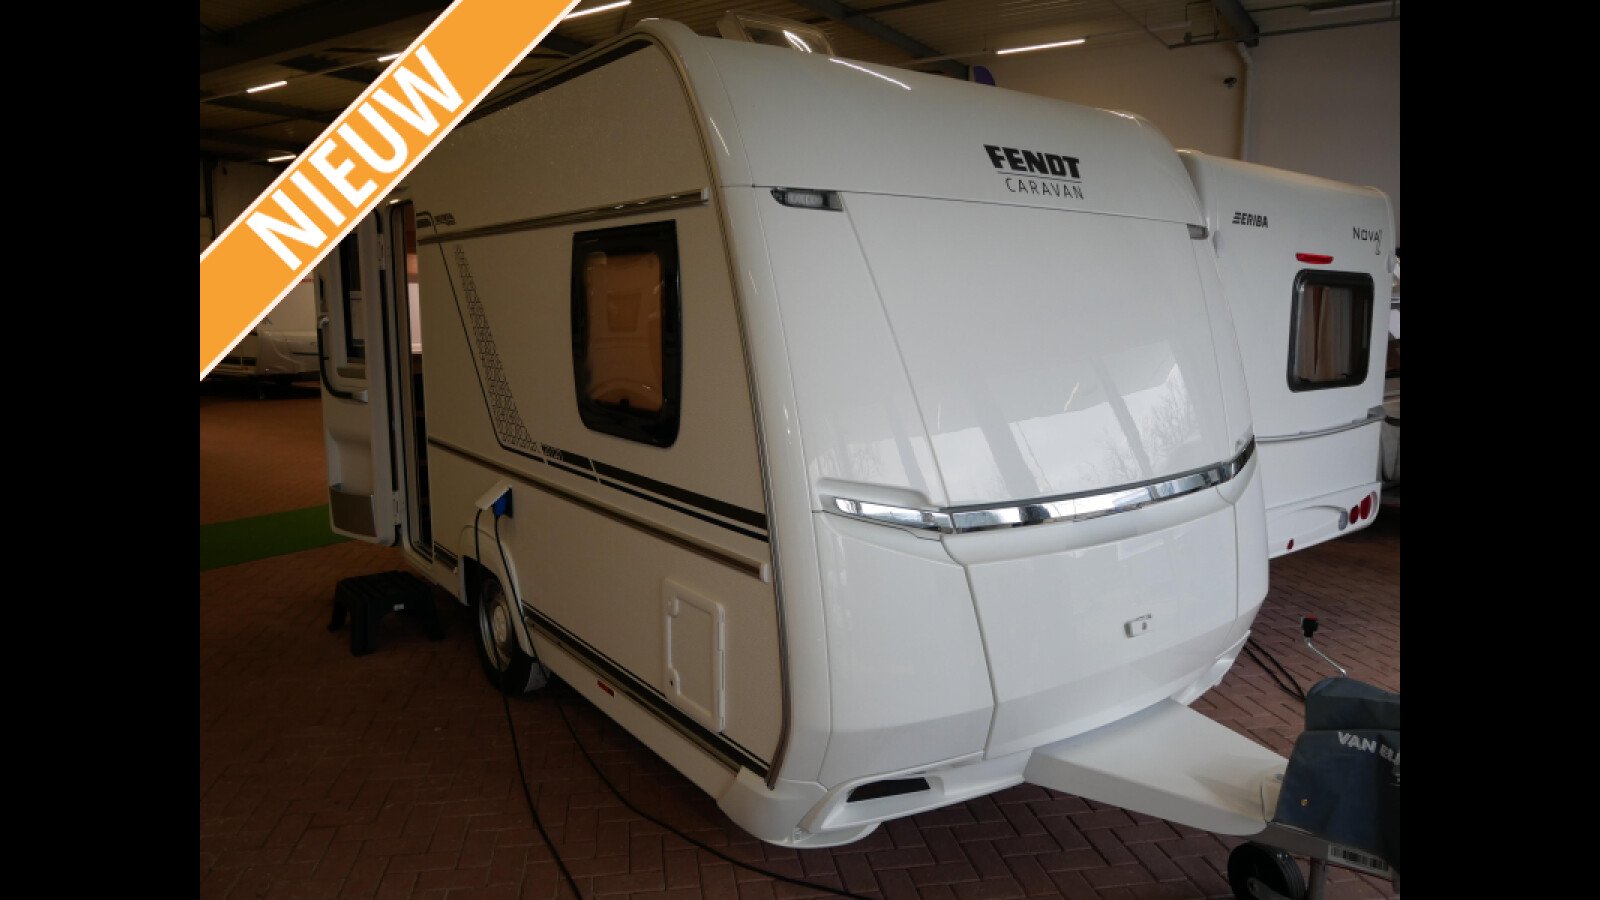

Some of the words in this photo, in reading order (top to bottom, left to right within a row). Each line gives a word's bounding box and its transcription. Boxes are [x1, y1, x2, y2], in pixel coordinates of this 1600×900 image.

[983, 144, 1081, 178] FENDT
[1005, 178, 1084, 200] CARAVAN
[1238, 212, 1269, 228] ERIBA
[1353, 226, 1380, 242] NOVA
[1338, 731, 1377, 753] VAN
